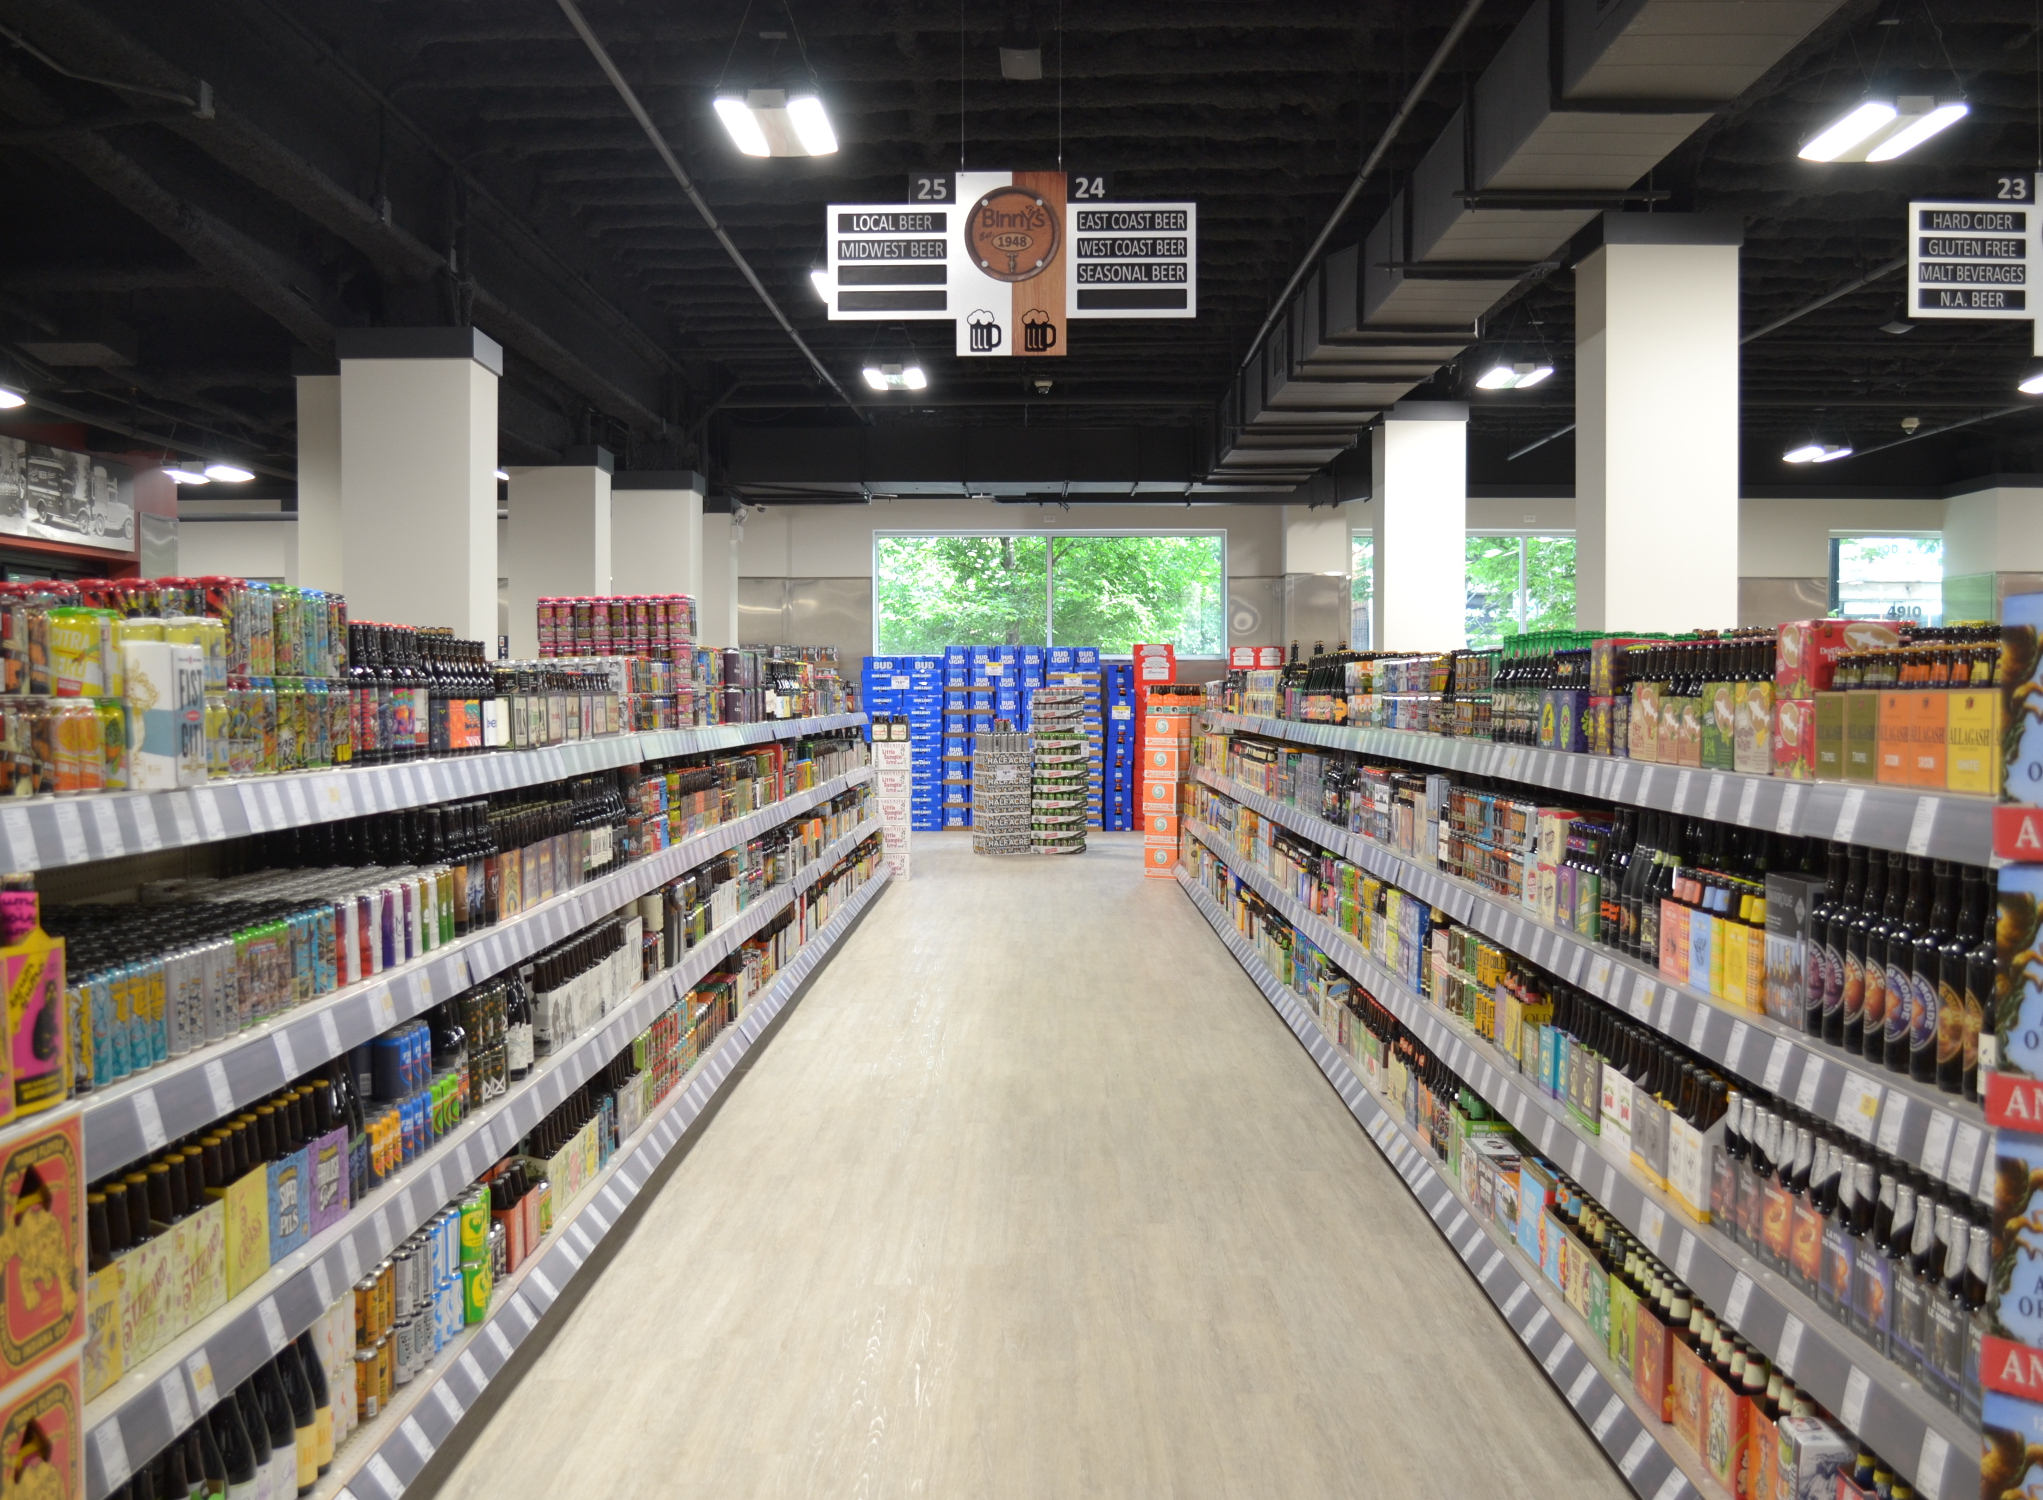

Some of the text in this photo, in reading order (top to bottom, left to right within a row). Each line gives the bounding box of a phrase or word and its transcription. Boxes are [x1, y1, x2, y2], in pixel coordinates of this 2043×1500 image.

[917, 179, 946, 200] 25
[1075, 178, 1105, 198] 24
[1998, 179, 2026, 199] 23
[853, 215, 932, 231] LOCAL BEER
[1079, 213, 1184, 229] EAST COAST BEER
[1933, 214, 2012, 229] HARD CIDER
[842, 242, 943, 258] MIDWEST BEER
[998, 236, 1027, 248] 1948
[1080, 239, 1184, 256] WEST COAST BEER
[1929, 240, 2016, 257] GLUTEN FREE
[1080, 265, 1184, 281] SEASONAL BEER
[1921, 266, 2023, 282] MALT BEVERAGES
[1940, 292, 2004, 307] N.A. BEER
[1887, 606, 1921, 618] 4910
[52, 627, 90, 651] CITRA
[1820, 647, 1849, 656] Dogfish
[179, 669, 202, 711] FIST
[1910, 726, 1945, 744] ALLAGASH
[1950, 729, 1990, 747] ALLAGASH
[1957, 760, 1979, 771] WHITE
[1895, 975, 1911, 1021] MONDE
[1919, 980, 1935, 1030] MONDE
[281, 1208, 299, 1237] PILS
[1826, 1229, 1833, 1238] LA
[1861, 1250, 1876, 1266] LA FIN
[1895, 1280, 1902, 1291] LE
[1937, 1301, 1951, 1317] TOUT
[1928, 1307, 1956, 1333] LE MONDE
